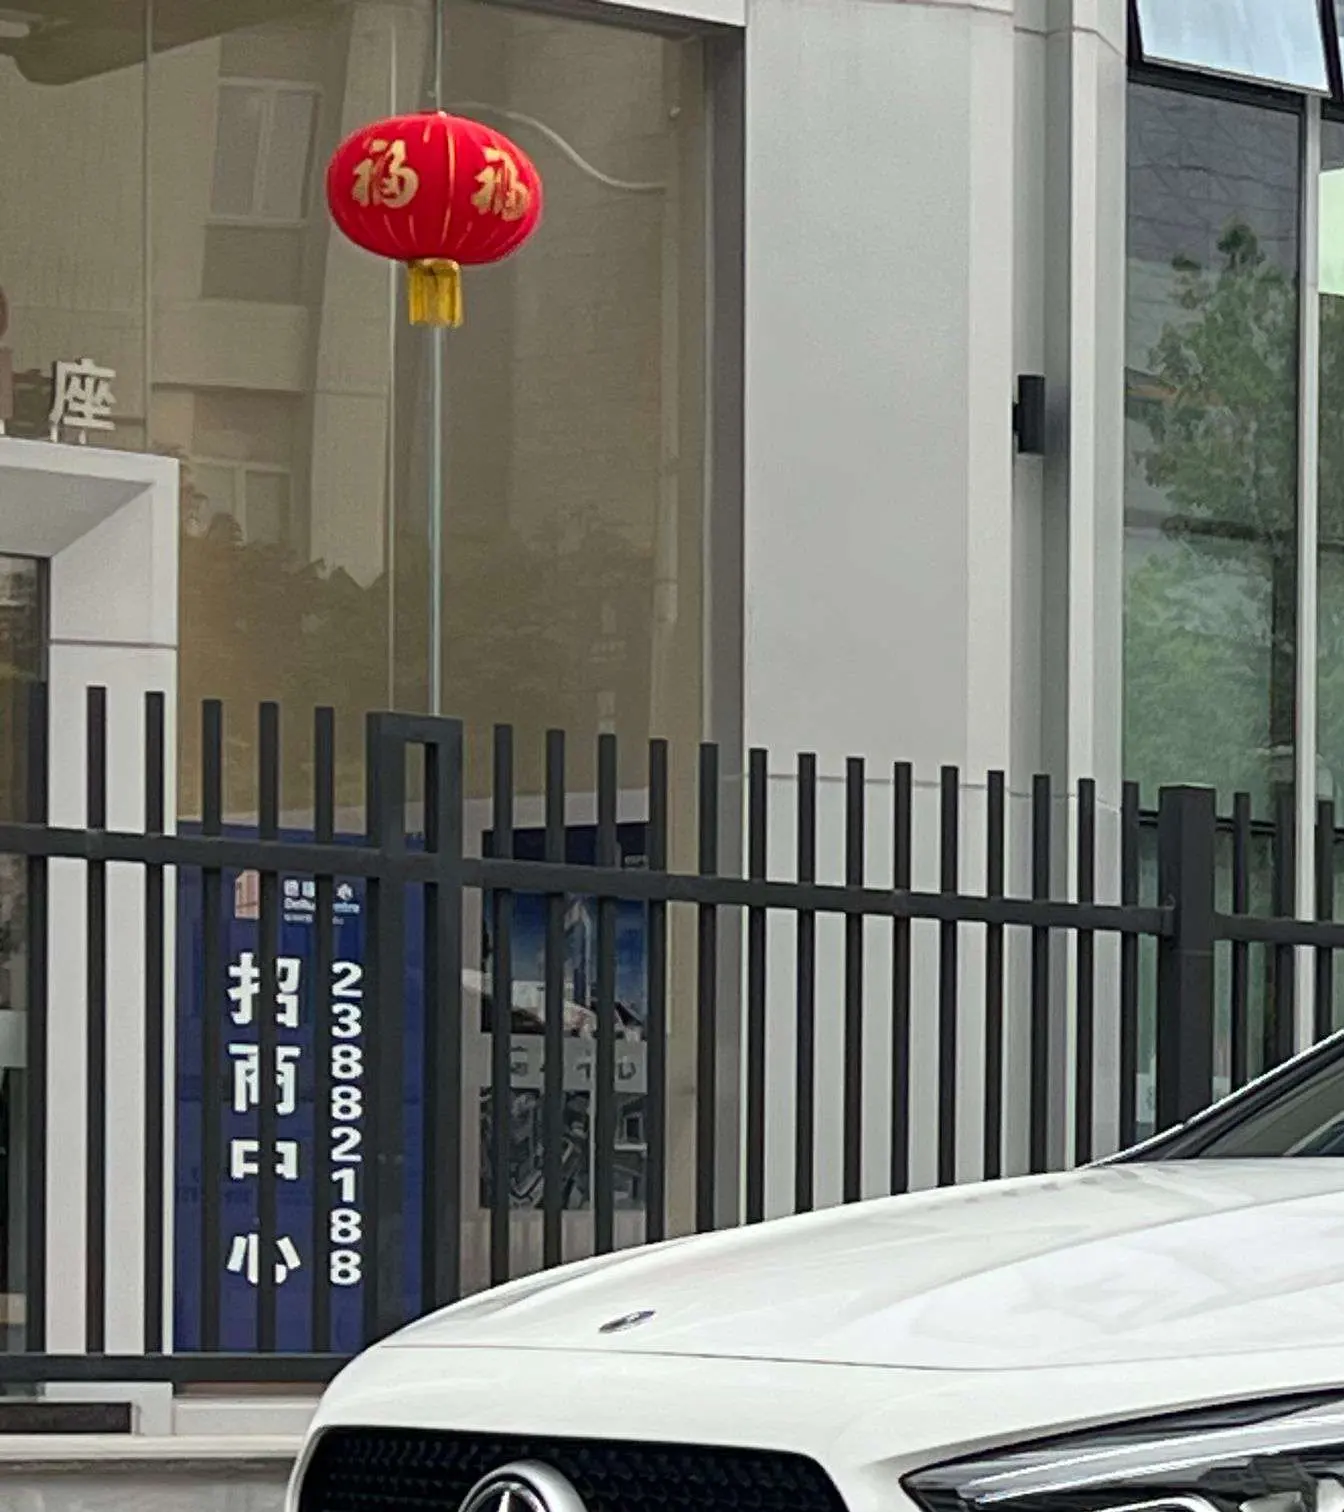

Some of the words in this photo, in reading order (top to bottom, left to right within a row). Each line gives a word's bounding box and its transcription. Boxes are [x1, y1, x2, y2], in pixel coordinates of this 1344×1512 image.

[352, 139, 419, 209] 福
[470, 146, 530, 222] 福
[49, 357, 116, 431] 座
[330, 961, 364, 1286] 23882188
